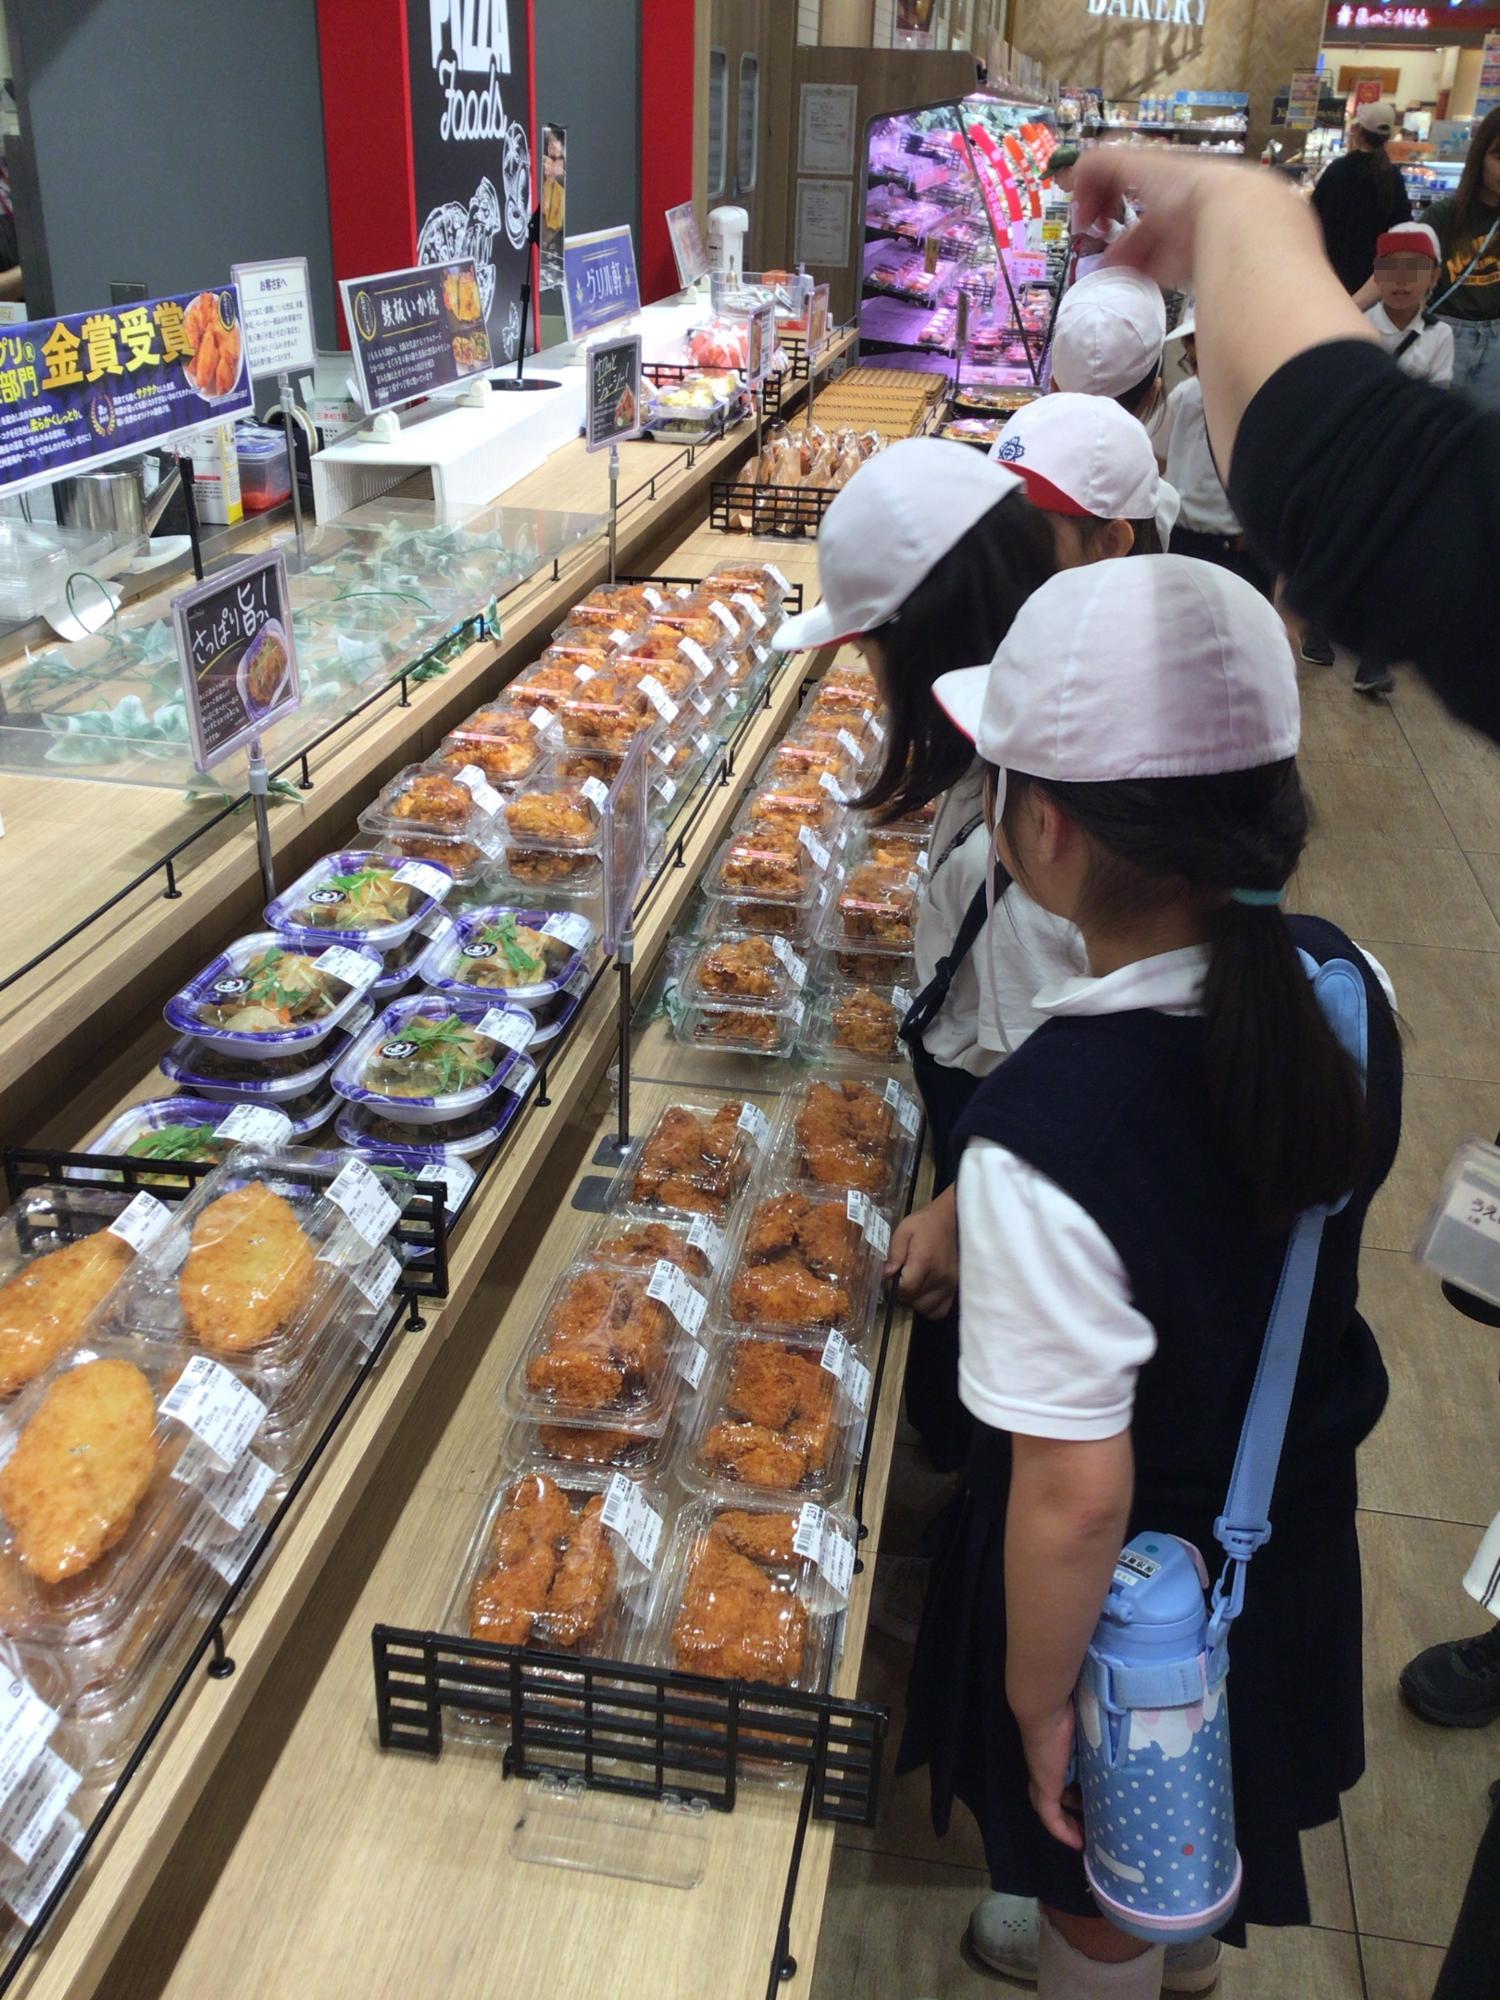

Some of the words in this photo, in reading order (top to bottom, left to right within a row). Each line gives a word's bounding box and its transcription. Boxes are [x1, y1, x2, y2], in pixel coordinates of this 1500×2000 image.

[439, 58, 508, 140] Foods
[586, 261, 622, 304] グリル軒
[41, 302, 196, 390] 金賞受賞
[806, 1505, 819, 1520] 231
